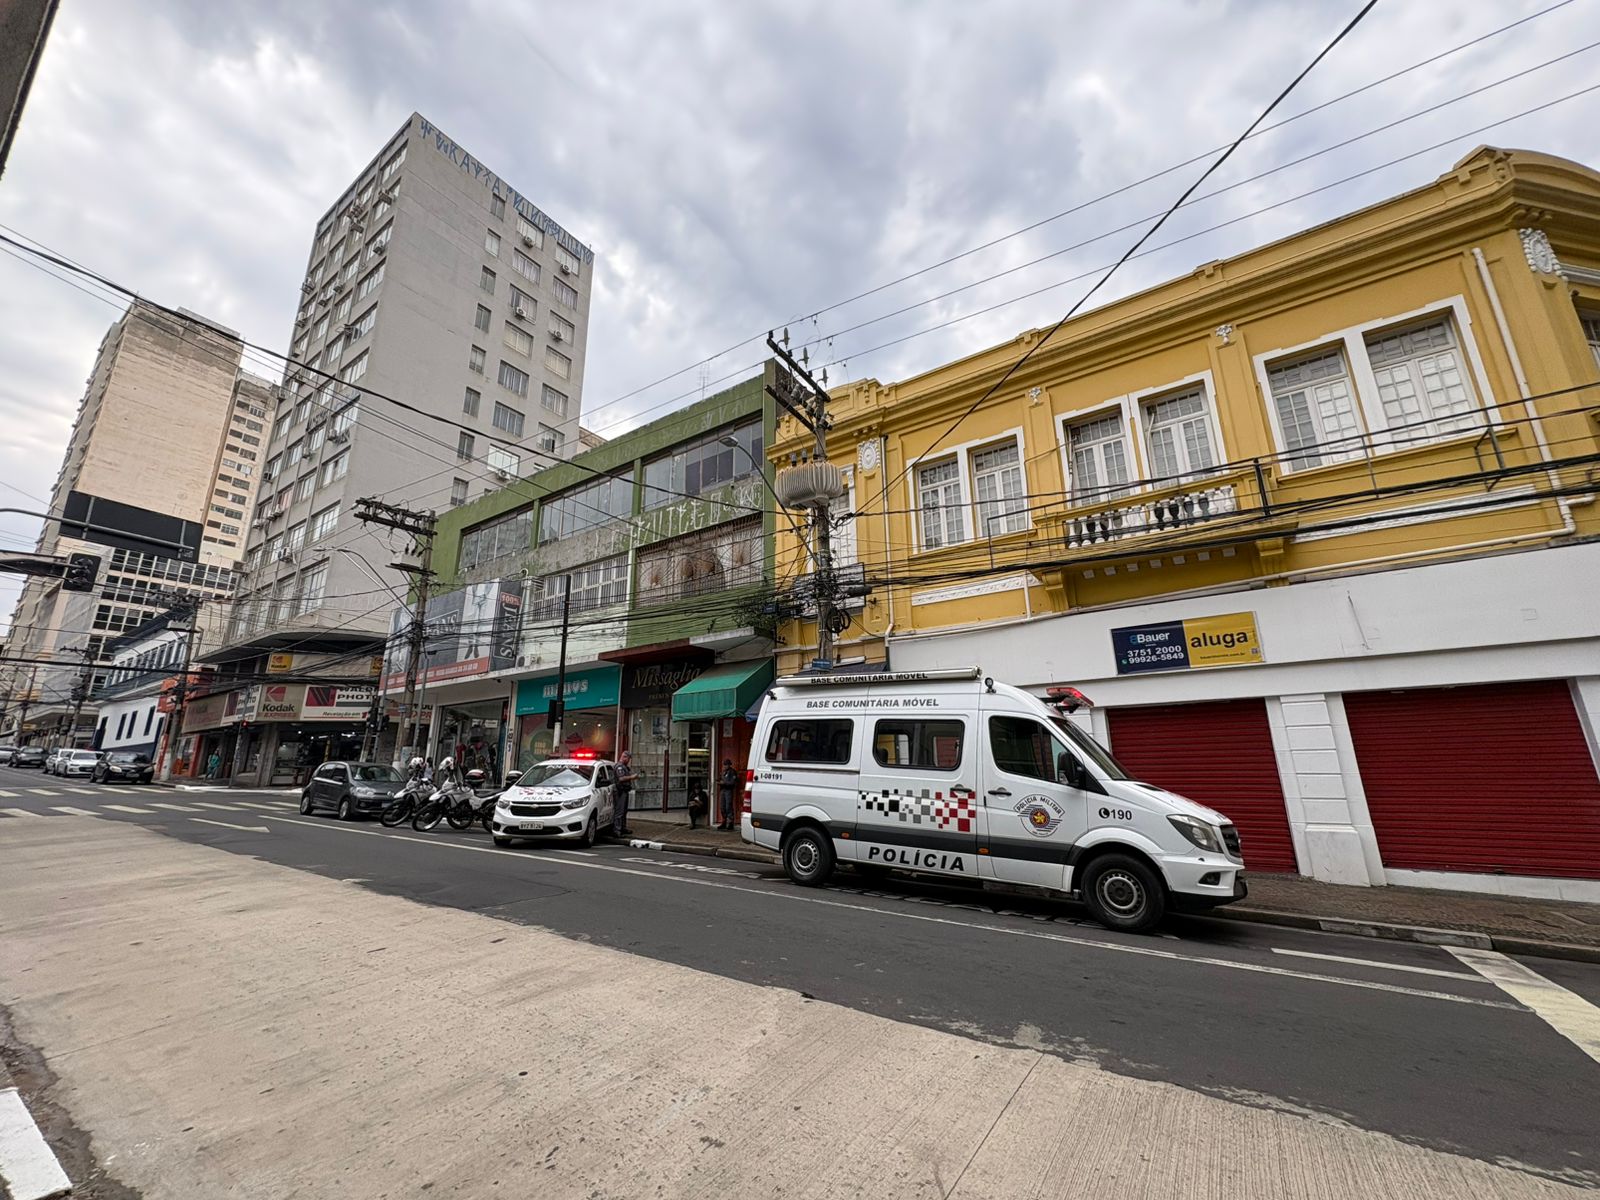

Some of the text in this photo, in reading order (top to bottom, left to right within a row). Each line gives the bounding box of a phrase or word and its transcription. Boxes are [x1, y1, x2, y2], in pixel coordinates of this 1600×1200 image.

[500, 602, 518, 658] JEANS
[1137, 631, 1170, 644] Bauer
[1191, 630, 1248, 648] aluga
[1127, 648, 1152, 658] 3751
[1155, 645, 1182, 655] 2000
[1128, 652, 1185, 664] 99926-5849
[632, 662, 702, 690] Missaglia
[262, 704, 295, 712] Kodak
[806, 697, 939, 709] BASE COMUNITÁRIA MÓVEL
[1040, 796, 1062, 814] MILITAR
[1111, 808, 1132, 821] 190
[868, 846, 965, 872] POLÍCIA
